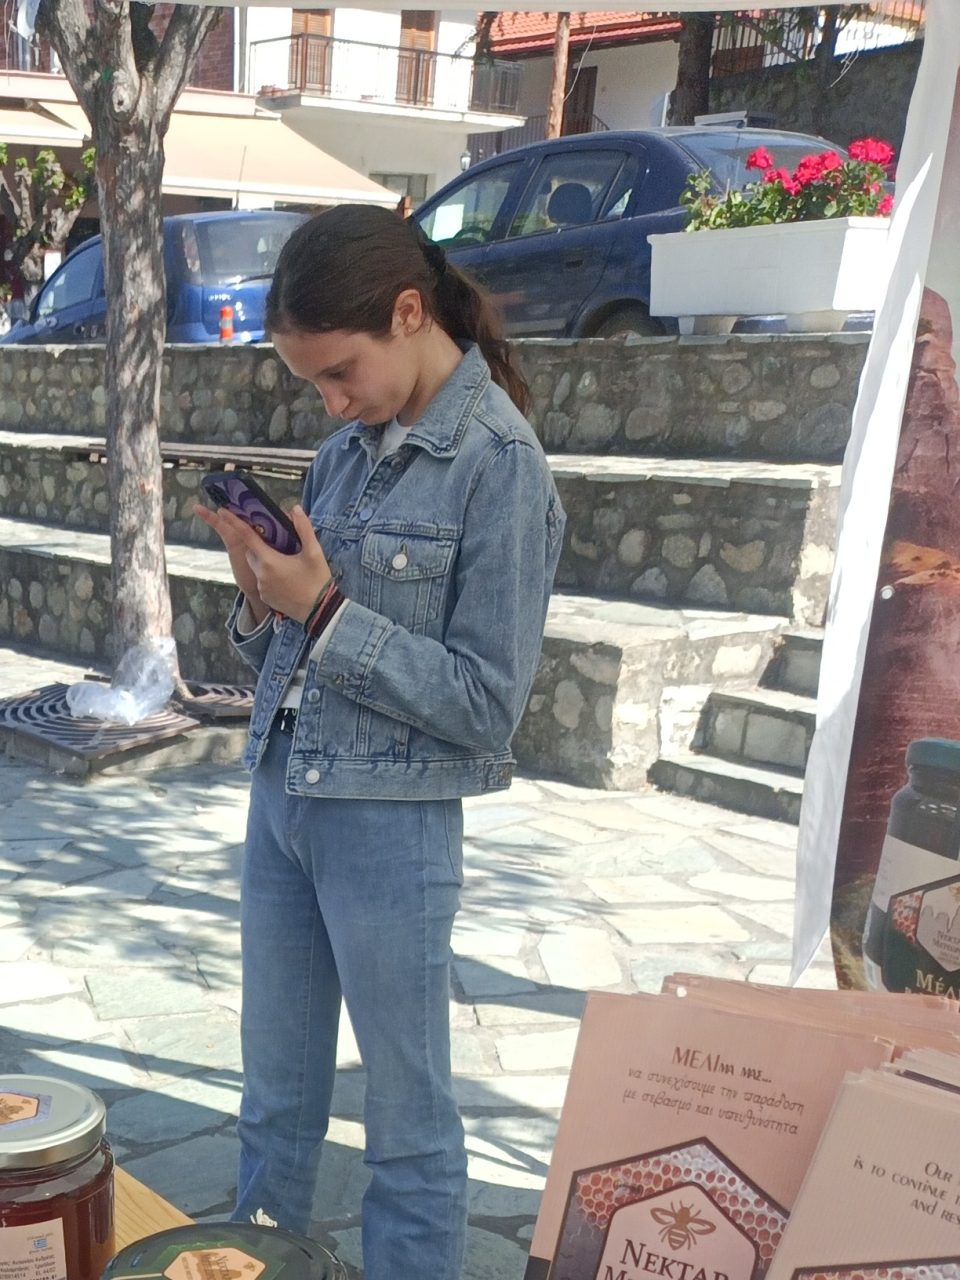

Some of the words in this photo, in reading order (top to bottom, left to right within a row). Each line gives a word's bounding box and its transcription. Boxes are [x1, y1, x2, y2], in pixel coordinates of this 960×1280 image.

[628, 1067, 642, 1079] να
[720, 1086, 738, 1099] την
[623, 1088, 636, 1103] με
[695, 1104, 713, 1116] και
